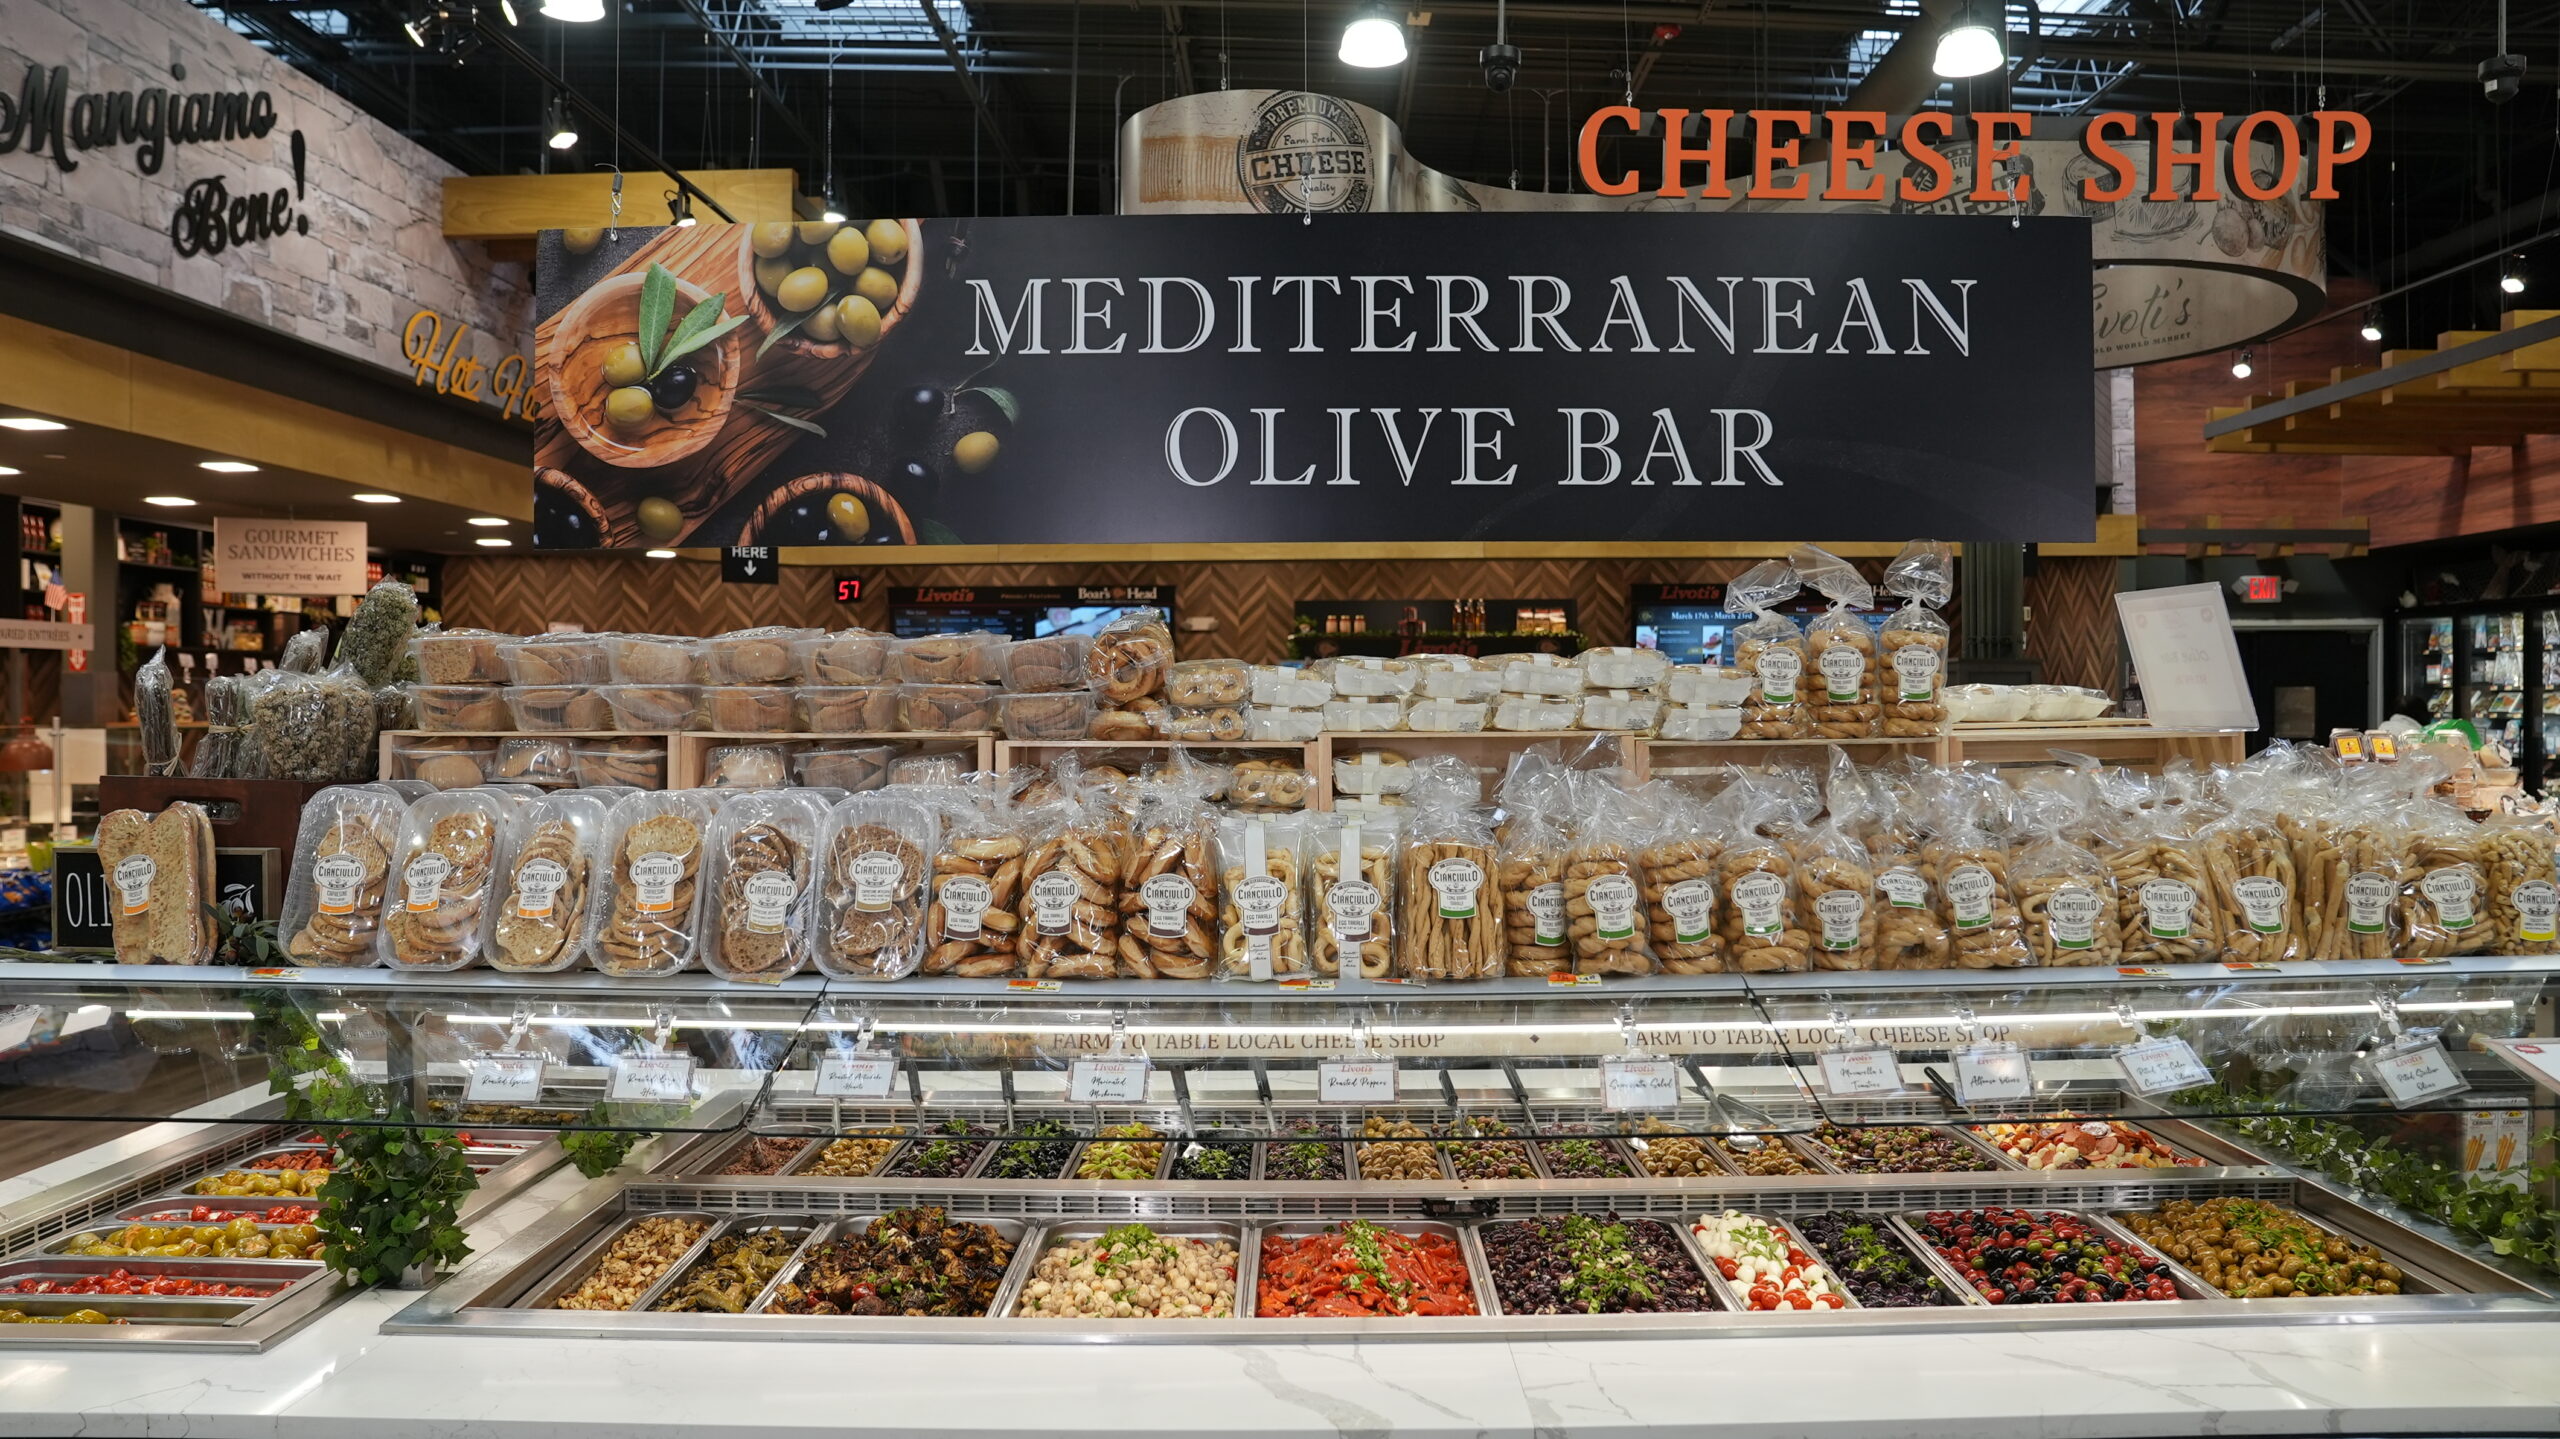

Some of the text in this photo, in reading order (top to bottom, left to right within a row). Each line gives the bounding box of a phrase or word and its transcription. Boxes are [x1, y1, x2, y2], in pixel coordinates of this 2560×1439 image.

[1265, 95, 1341, 127] PREMIUM
[0, 63, 277, 175] Mangiamo
[1311, 131, 1337, 144] Fresh
[1577, 106, 2373, 202] CHEESE SHOP
[1250, 149, 1366, 181] CHEESE
[172, 129, 308, 258] Bene!
[965, 274, 1978, 357] MEDITERRANEAN
[2116, 340, 2150, 352] WORLD
[2152, 332, 2191, 346] MARKET
[403, 310, 536, 423] Hot Fo
[1164, 405, 1784, 488] OLIVE BAR
[245, 529, 339, 545] GOURMET
[228, 544, 355, 562] SANDWICHES
[732, 546, 768, 559] HERE
[242, 572, 342, 582] WITHOUT THE WAIT
[838, 581, 861, 600] 57
[1078, 587, 1157, 600] Boar's Head
[1661, 585, 1721, 600] Livoti's
[2249, 577, 2278, 599] EXIT
[916, 588, 976, 603] Livoti's
[1671, 611, 1697, 620] March
[1698, 611, 1710, 620] 17th
[1714, 611, 1739, 620] March
[1760, 657, 1798, 670] CIANCIULLO
[1822, 656, 1861, 669] CIANCIULLO
[1895, 656, 1936, 668] CIANCIULLO
[117, 864, 151, 881] CIANCIULLO
[318, 864, 361, 877] CIANCIULLO
[408, 863, 446, 878] CIANCIULLO
[634, 864, 679, 876] CIANCIULLO
[854, 863, 898, 875] CIANCIULLO
[520, 871, 561, 883] CIANCIULLO
[1434, 870, 1478, 882] CIANCIULLO
[1881, 878, 1923, 888] CIANCIULLO
[1949, 877, 1989, 894] CIANCIULLO
[2426, 880, 2470, 894] CIANCIULLO
[749, 884, 793, 897] CIANCIULLO
[943, 890, 987, 903] CIANCIULLO
[1034, 884, 1075, 897] CIANCIULLO
[1145, 887, 1190, 899] CIANCIULLO
[1238, 888, 1282, 900] CIANCIULLO
[1590, 890, 1633, 902] CIANCIULLO
[1736, 884, 1780, 899] CIANCIULLO
[2145, 891, 2190, 903] CIANCIULLO
[2236, 887, 2281, 898] CIANCIULLO
[2348, 884, 2390, 897] CIANCIULLO
[66, 872, 112, 928] OLI
[1331, 893, 1376, 905] CIANCIULLO
[1532, 896, 1565, 908] CIANCIU
[1668, 890, 1709, 908] CIANCIULLO
[2517, 892, 2556, 905] CIANCIULLO
[1818, 901, 1861, 913] CIANCIULLO
[2053, 899, 2097, 912] CIANCIULLO
[1053, 1033, 1445, 1049] FARM TO TABLE LOCAL CHEESE SHOP
[1624, 1030, 1681, 1047] ARM
[1687, 1030, 1716, 1046] TO
[1722, 1028, 1790, 1046] TABLE
[1871, 1027, 1949, 1043] CHEESE
